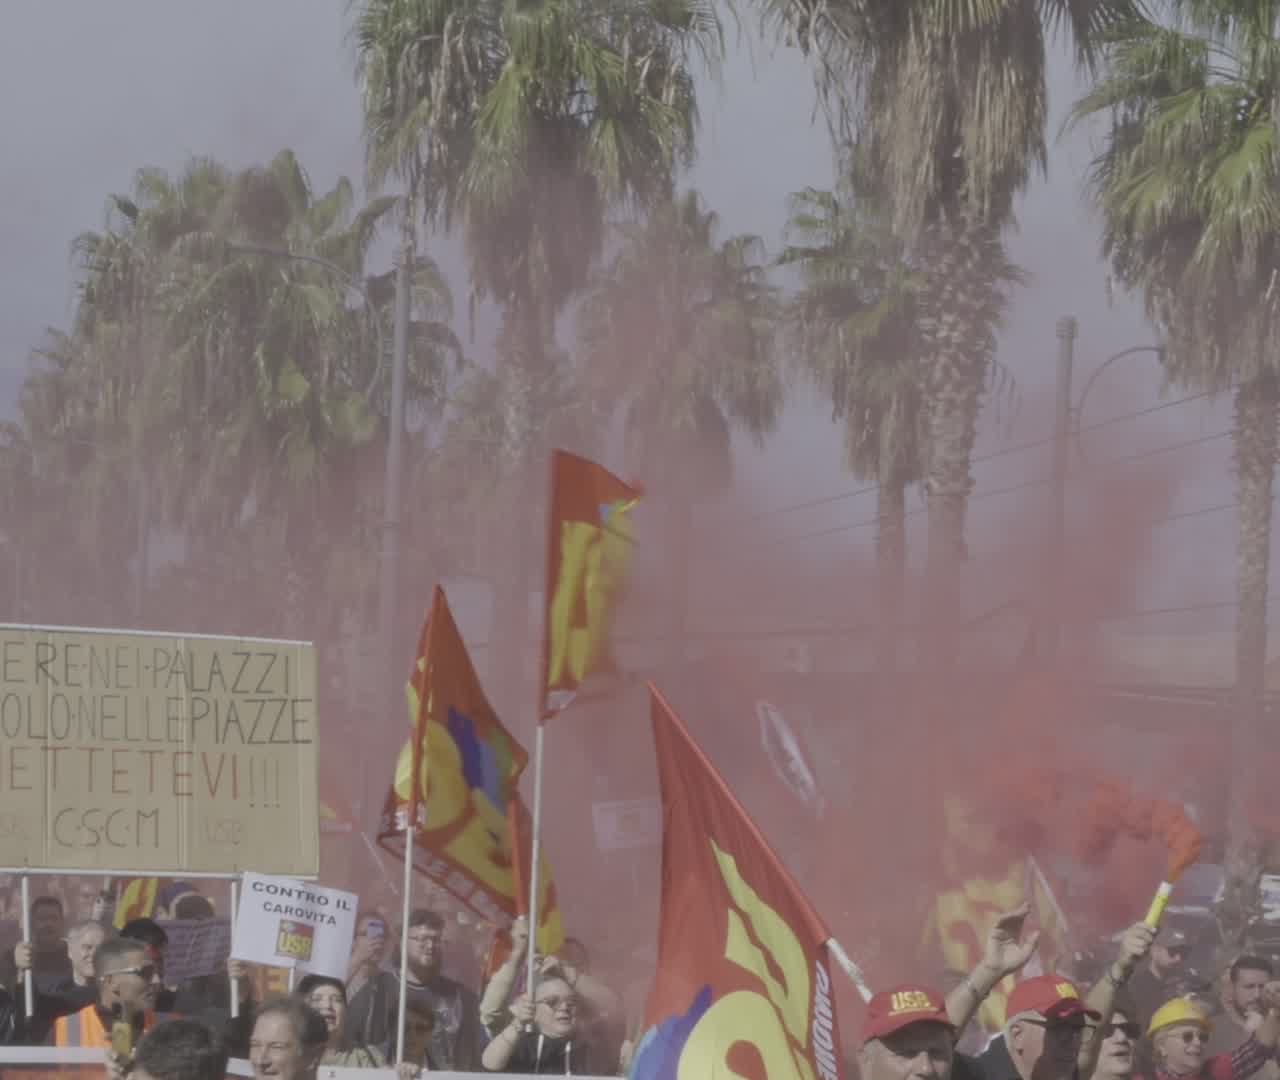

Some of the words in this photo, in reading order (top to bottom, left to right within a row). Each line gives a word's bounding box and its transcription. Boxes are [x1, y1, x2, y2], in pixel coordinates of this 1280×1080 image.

[77, 694, 185, 743] NELLE
[190, 698, 313, 744] PIAZZE
[252, 881, 329, 906] CONTRO
[335, 898, 352, 911] IL
[263, 901, 337, 925] CAROVITA
